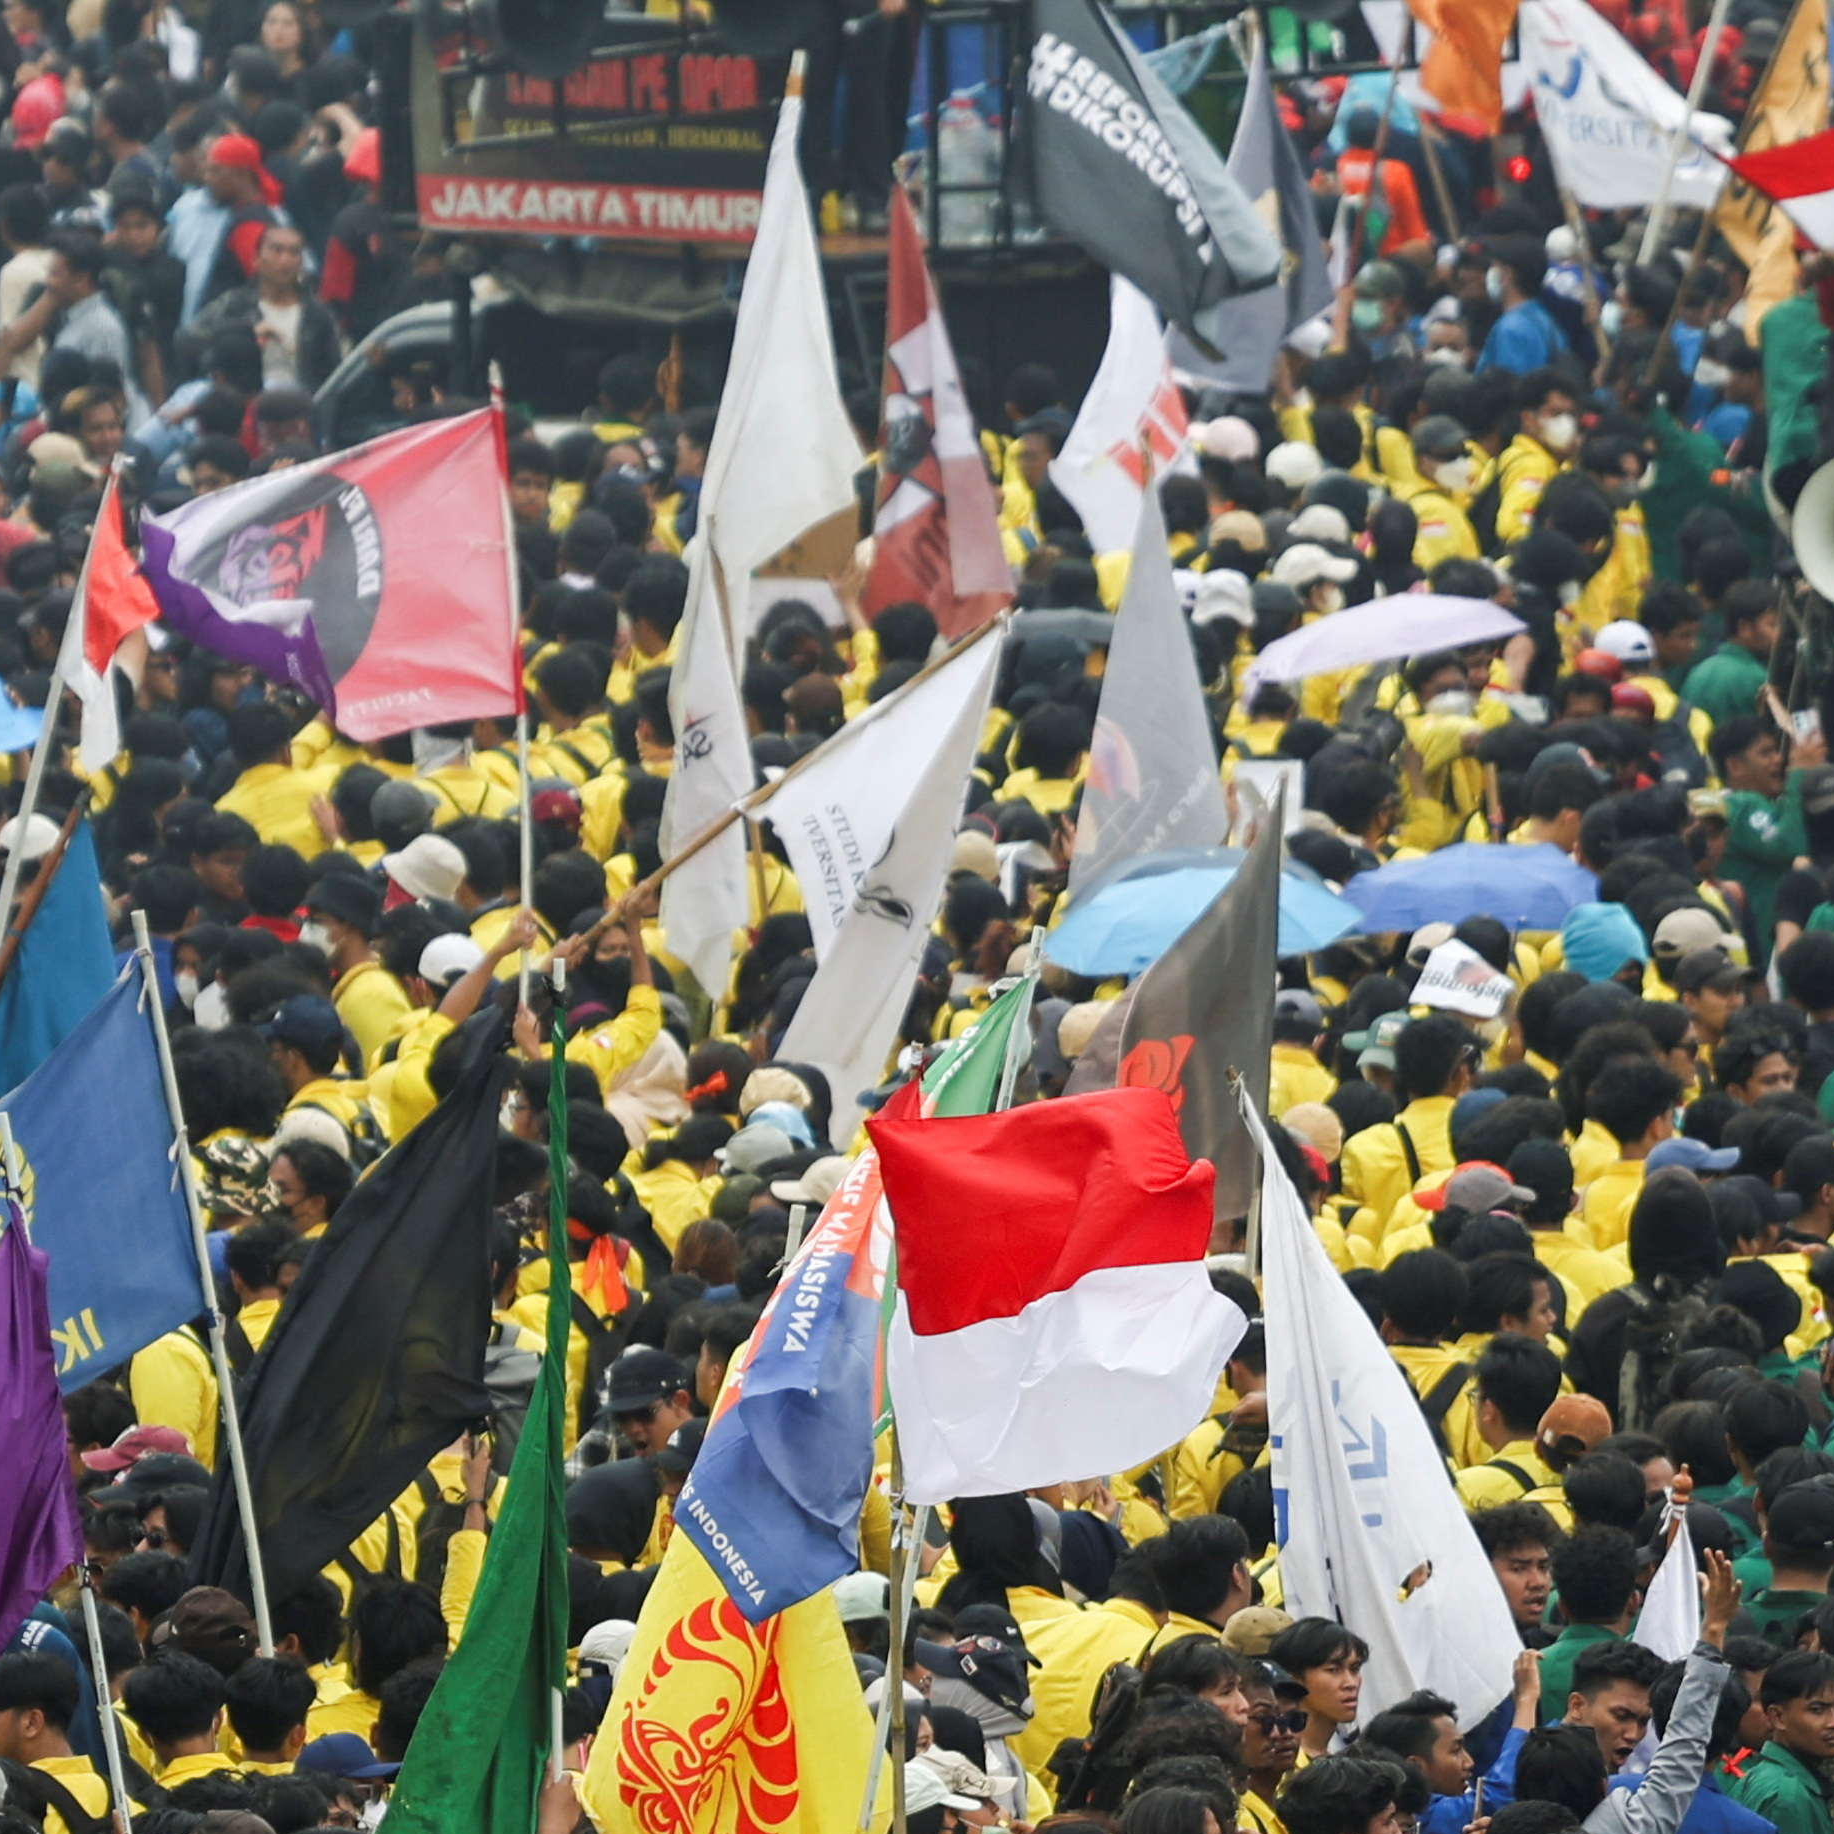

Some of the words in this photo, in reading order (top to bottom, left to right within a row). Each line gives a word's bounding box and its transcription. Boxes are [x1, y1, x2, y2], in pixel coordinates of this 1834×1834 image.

[430, 182, 628, 226] JAKARTA
[633, 190, 763, 232] TIMUR
[826, 802, 862, 863] STUDI
[783, 1203, 858, 1352] MAHASISWA
[688, 1498, 768, 1607] INDONESIA
